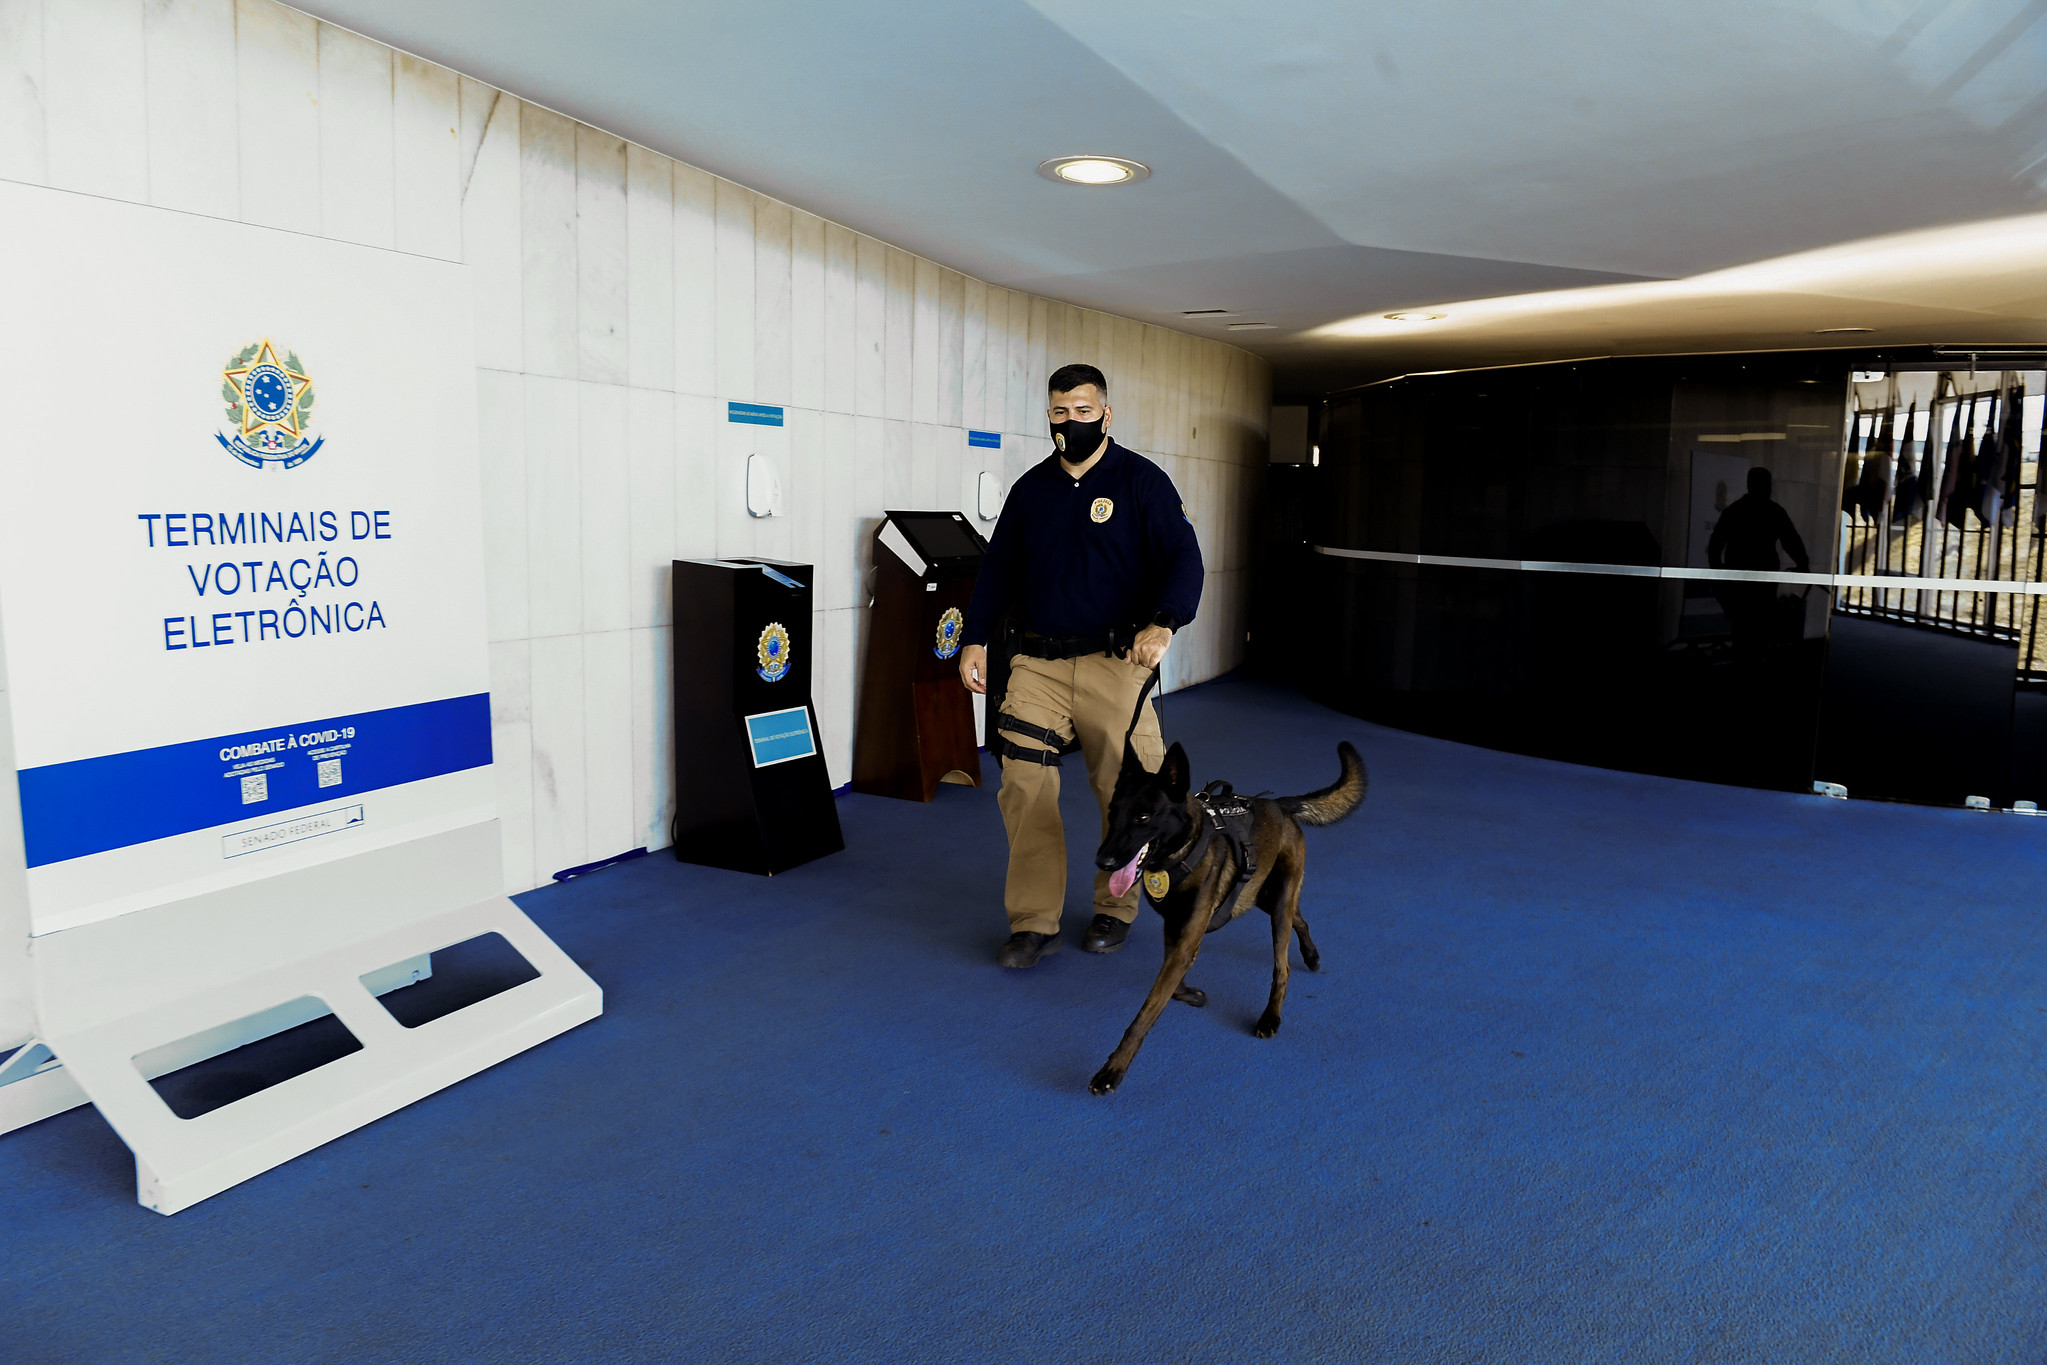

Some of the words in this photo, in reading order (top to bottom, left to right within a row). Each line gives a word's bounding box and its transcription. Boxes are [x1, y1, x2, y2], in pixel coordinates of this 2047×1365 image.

[138, 510, 338, 547] TERMINAIS
[351, 510, 392, 540] DE
[188, 550, 358, 598] VOTAÇÃO
[164, 598, 386, 651] ELETRÔNICA
[219, 738, 286, 761] COMBATE
[287, 734, 298, 749] À
[299, 727, 356, 747] COVID-19
[242, 829, 286, 848] SENADO
[290, 819, 331, 835] FEDERAL
